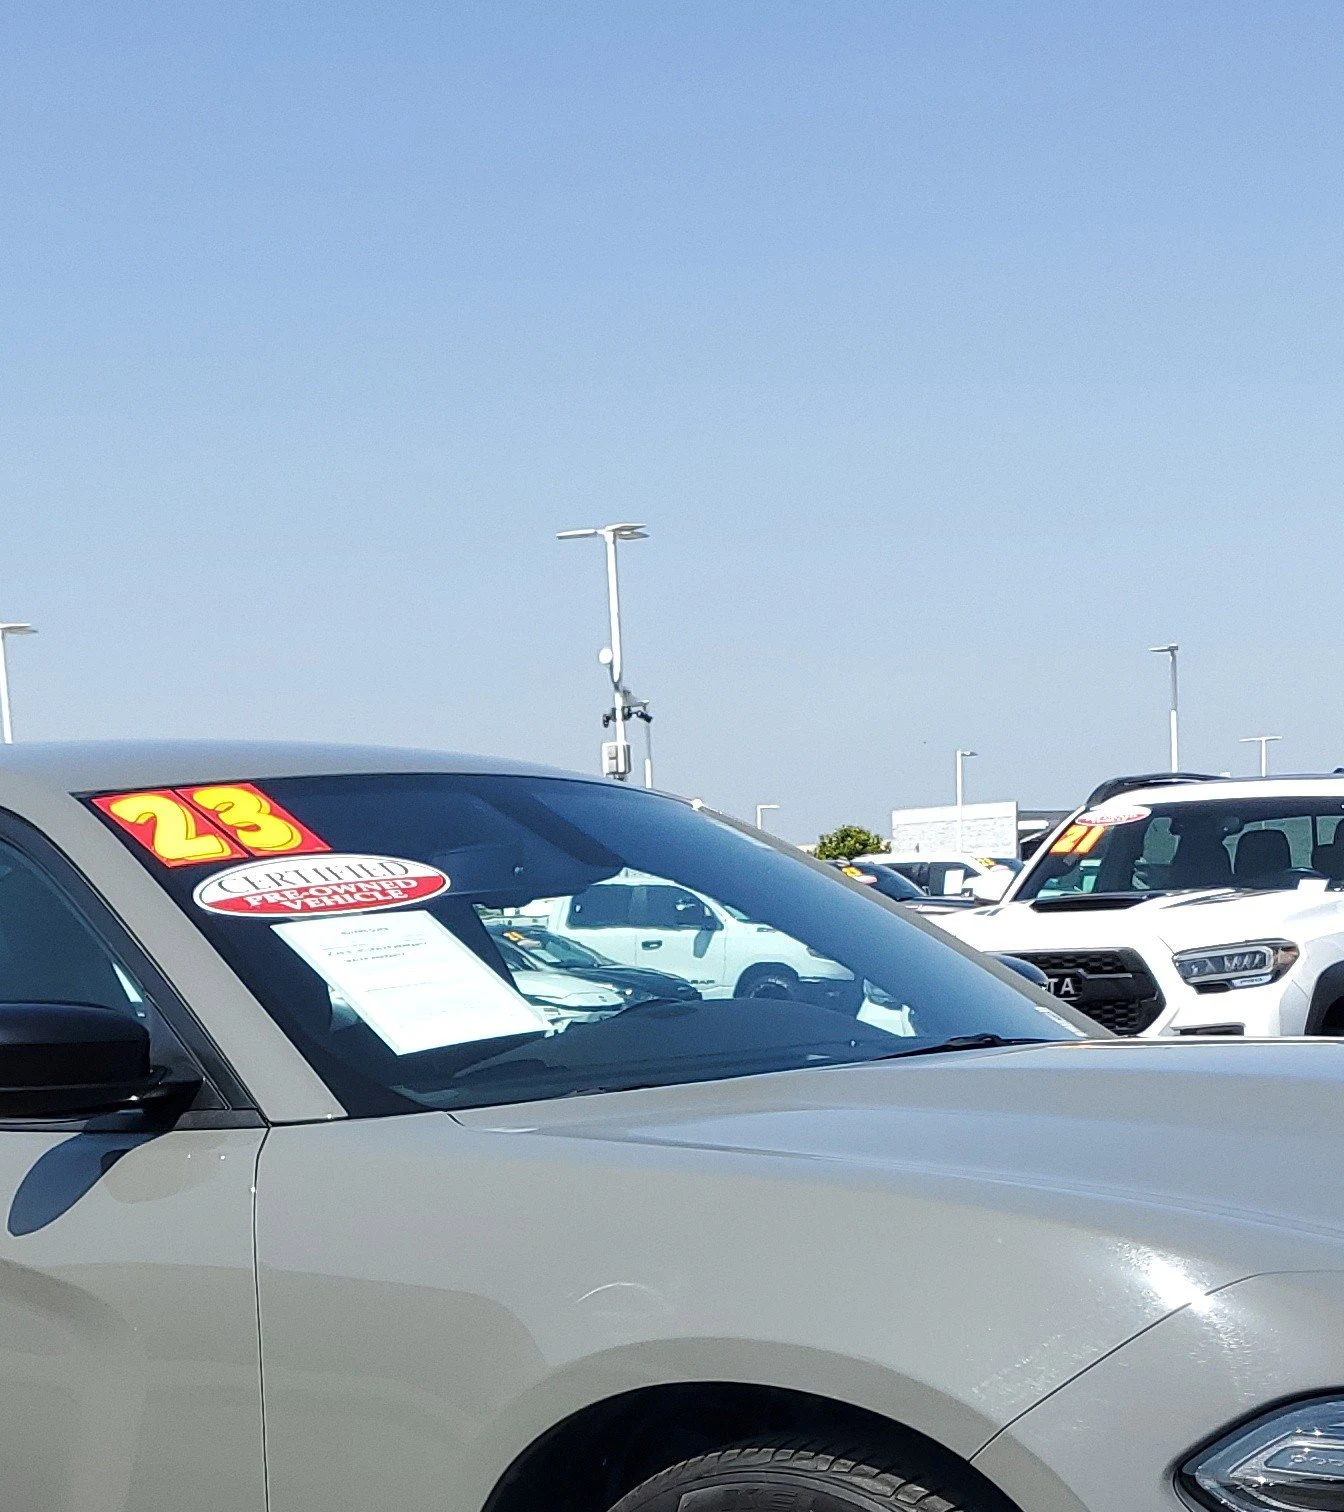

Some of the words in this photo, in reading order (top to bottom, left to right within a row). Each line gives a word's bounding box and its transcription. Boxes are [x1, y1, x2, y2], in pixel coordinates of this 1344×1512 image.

[109, 787, 303, 861] 23
[218, 860, 410, 894] CERTIFIED
[243, 878, 418, 907] PRE-OWNED
[284, 889, 409, 912] VEHICLE
